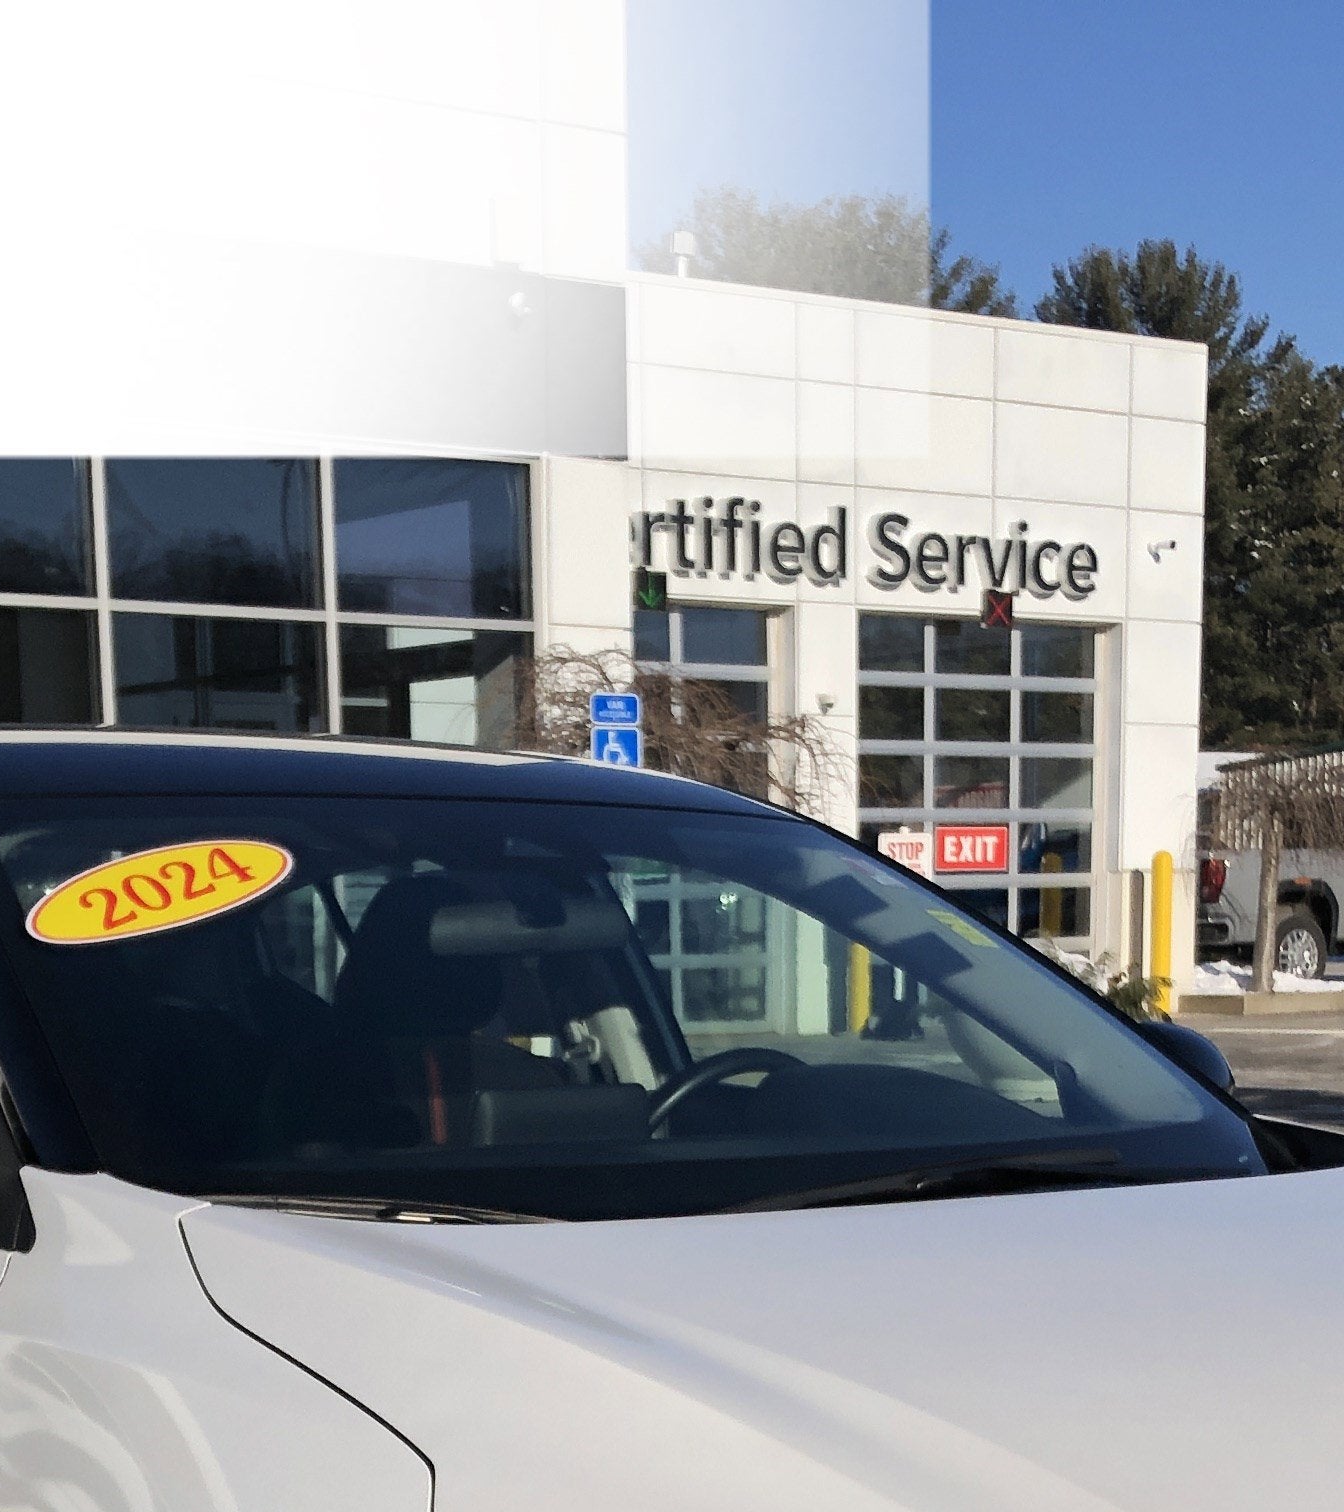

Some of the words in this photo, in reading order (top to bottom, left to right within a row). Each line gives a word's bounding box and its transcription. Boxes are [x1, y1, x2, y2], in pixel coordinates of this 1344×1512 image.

[875, 512, 1099, 593] Service
[888, 842, 924, 860] STOP
[943, 835, 998, 863] EXIT
[79, 846, 256, 930] 2024
